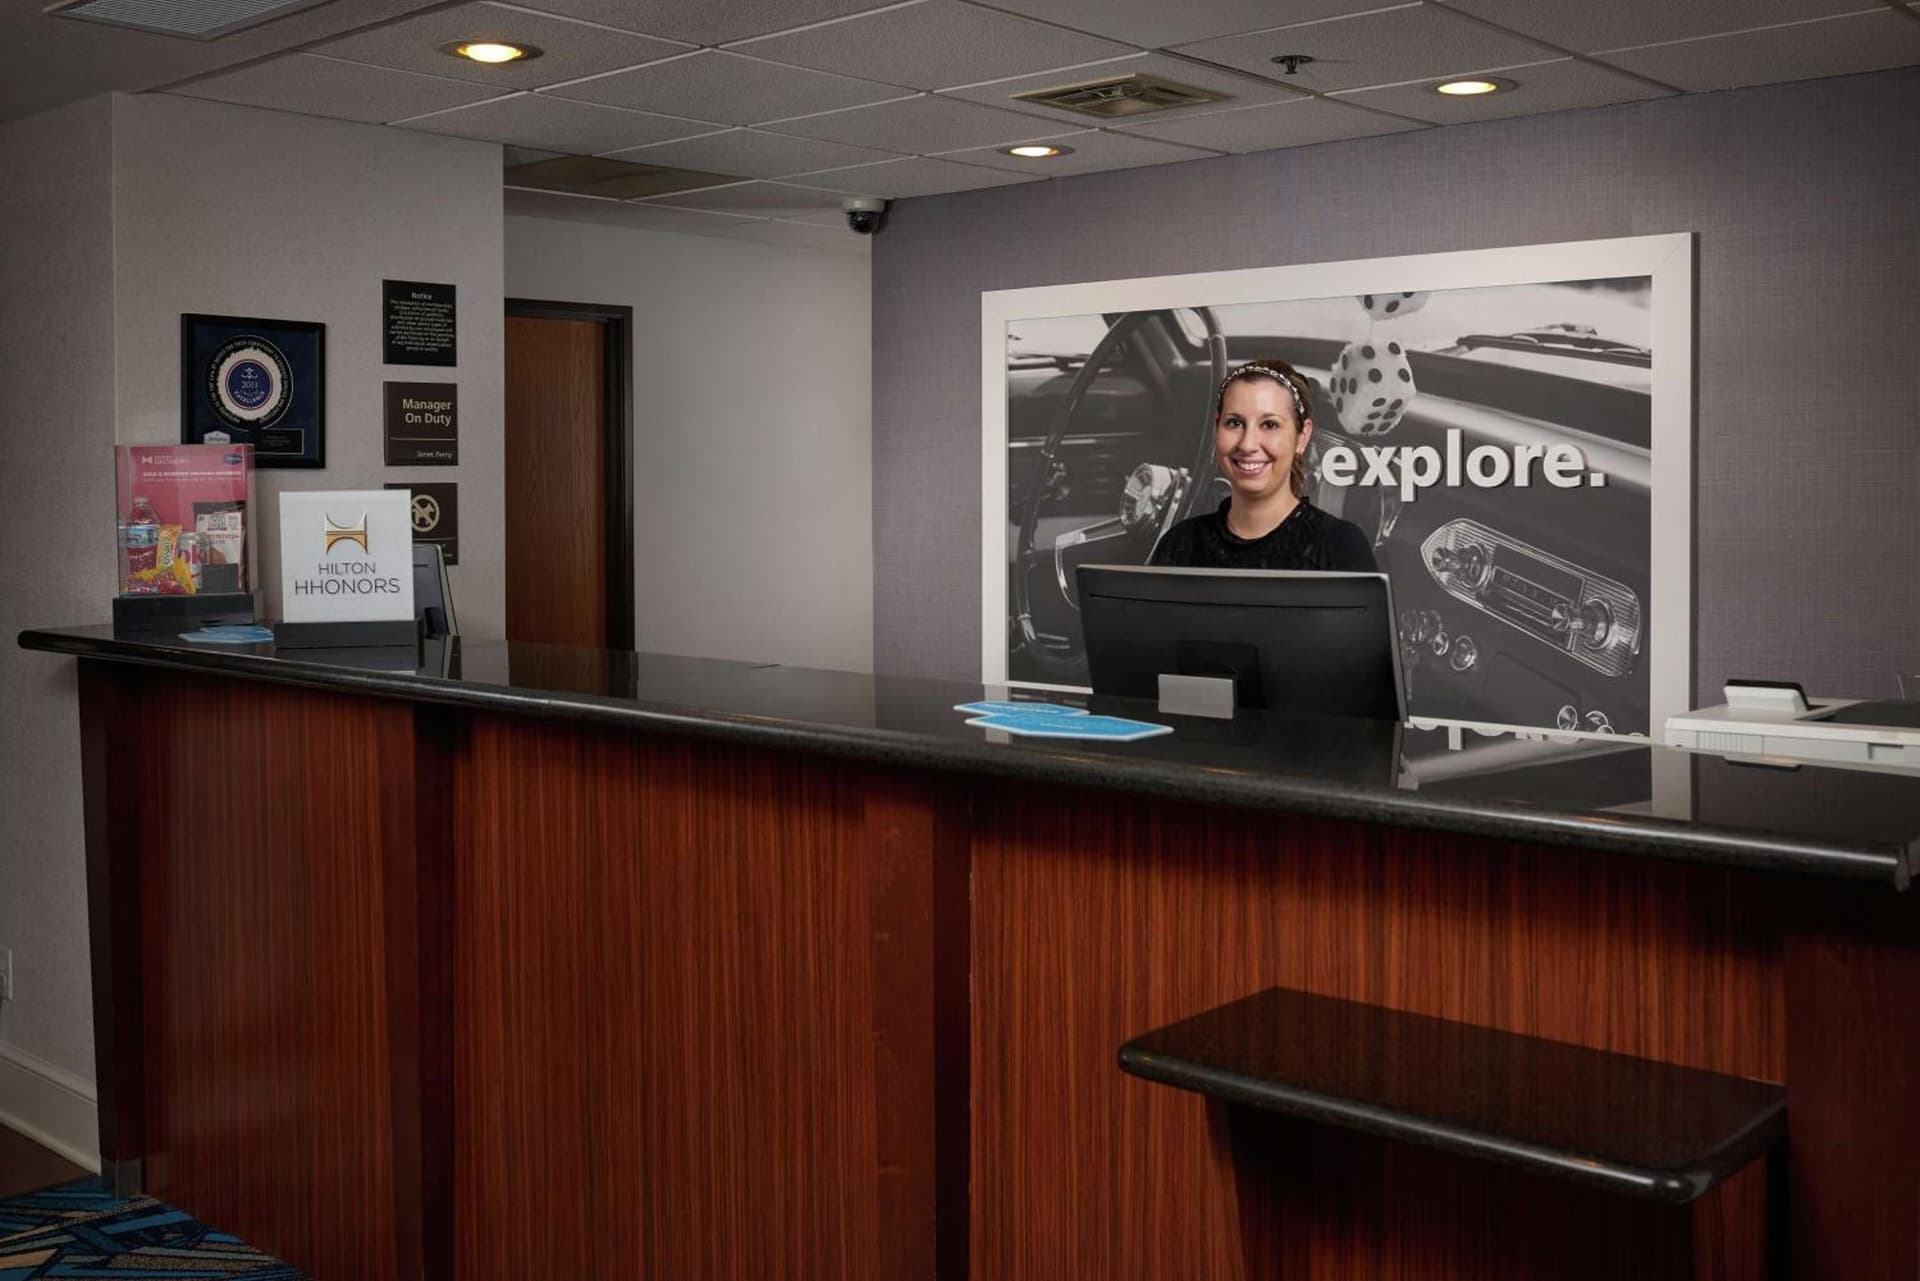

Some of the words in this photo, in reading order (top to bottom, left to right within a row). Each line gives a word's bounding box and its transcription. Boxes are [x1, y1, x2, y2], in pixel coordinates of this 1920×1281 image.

[402, 398, 452, 413] Manager
[405, 412, 422, 423] On
[424, 412, 452, 427] Duty
[1321, 428, 1609, 502] explore.
[318, 562, 377, 576] HILTON
[295, 578, 401, 595] HHONORS
